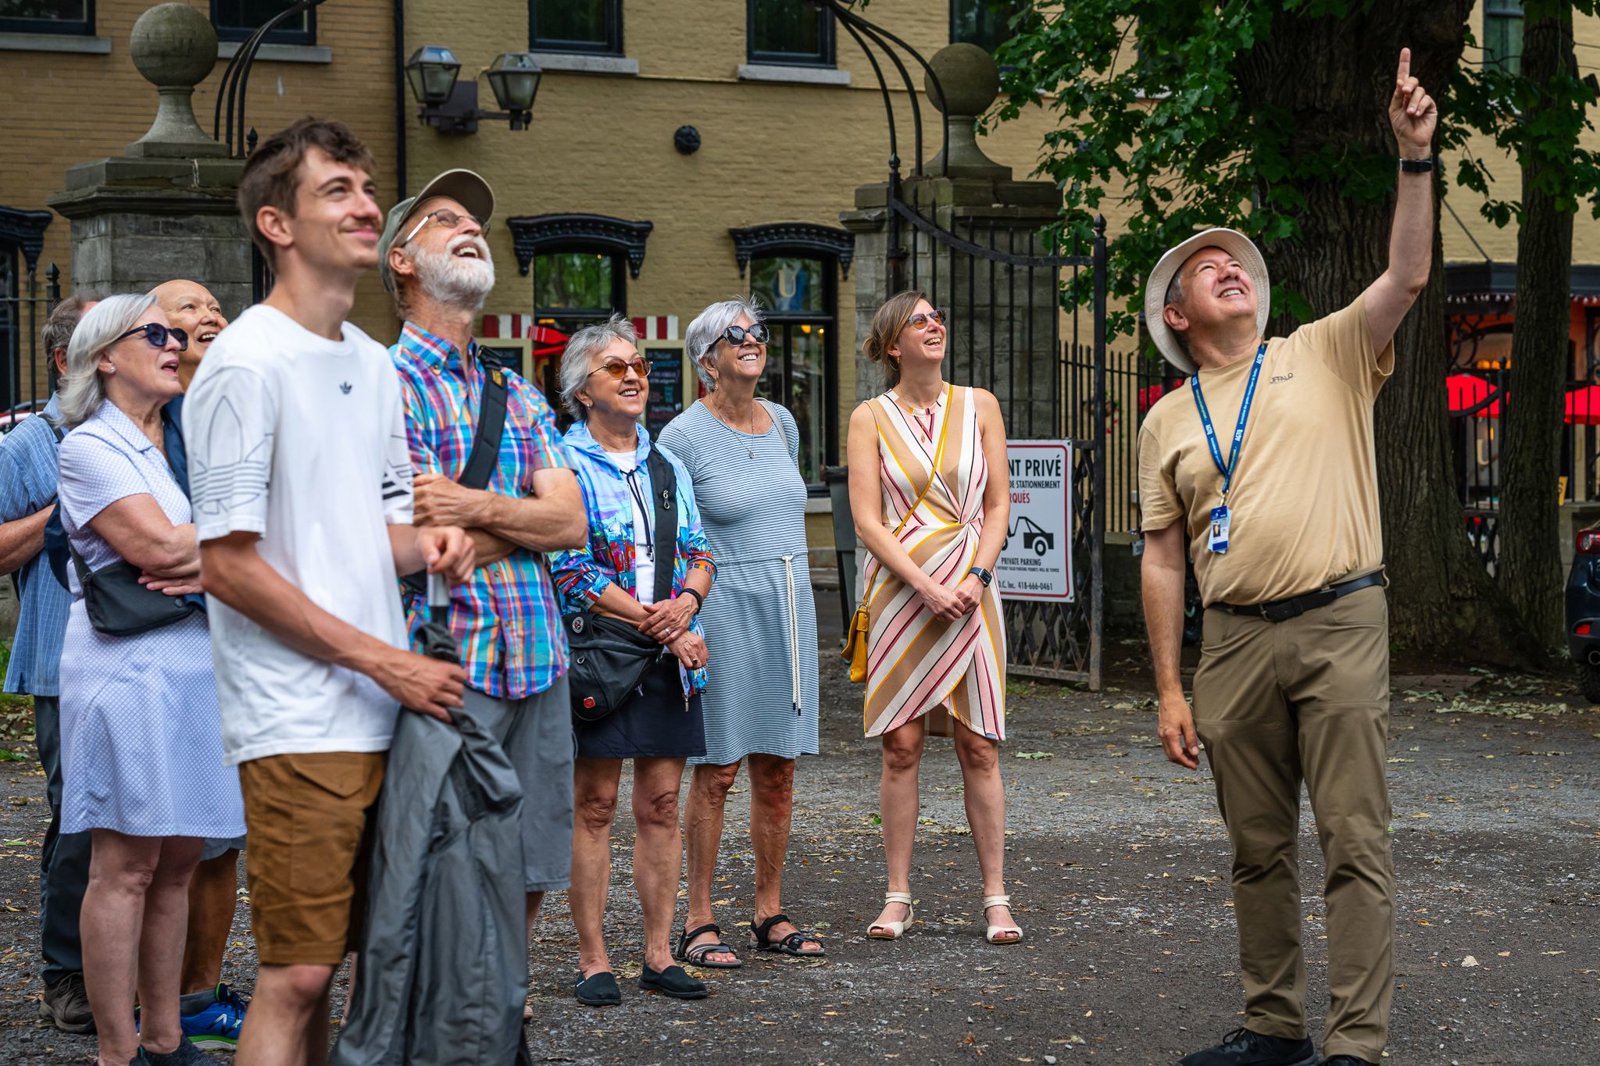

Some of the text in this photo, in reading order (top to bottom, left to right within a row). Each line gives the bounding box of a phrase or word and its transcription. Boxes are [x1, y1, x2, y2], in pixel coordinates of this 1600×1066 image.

[1025, 454, 1061, 477] PRIVÉ
[1016, 480, 1061, 489] STATIONNEMENT
[1001, 557, 1042, 566] PRIVATE PARKING
